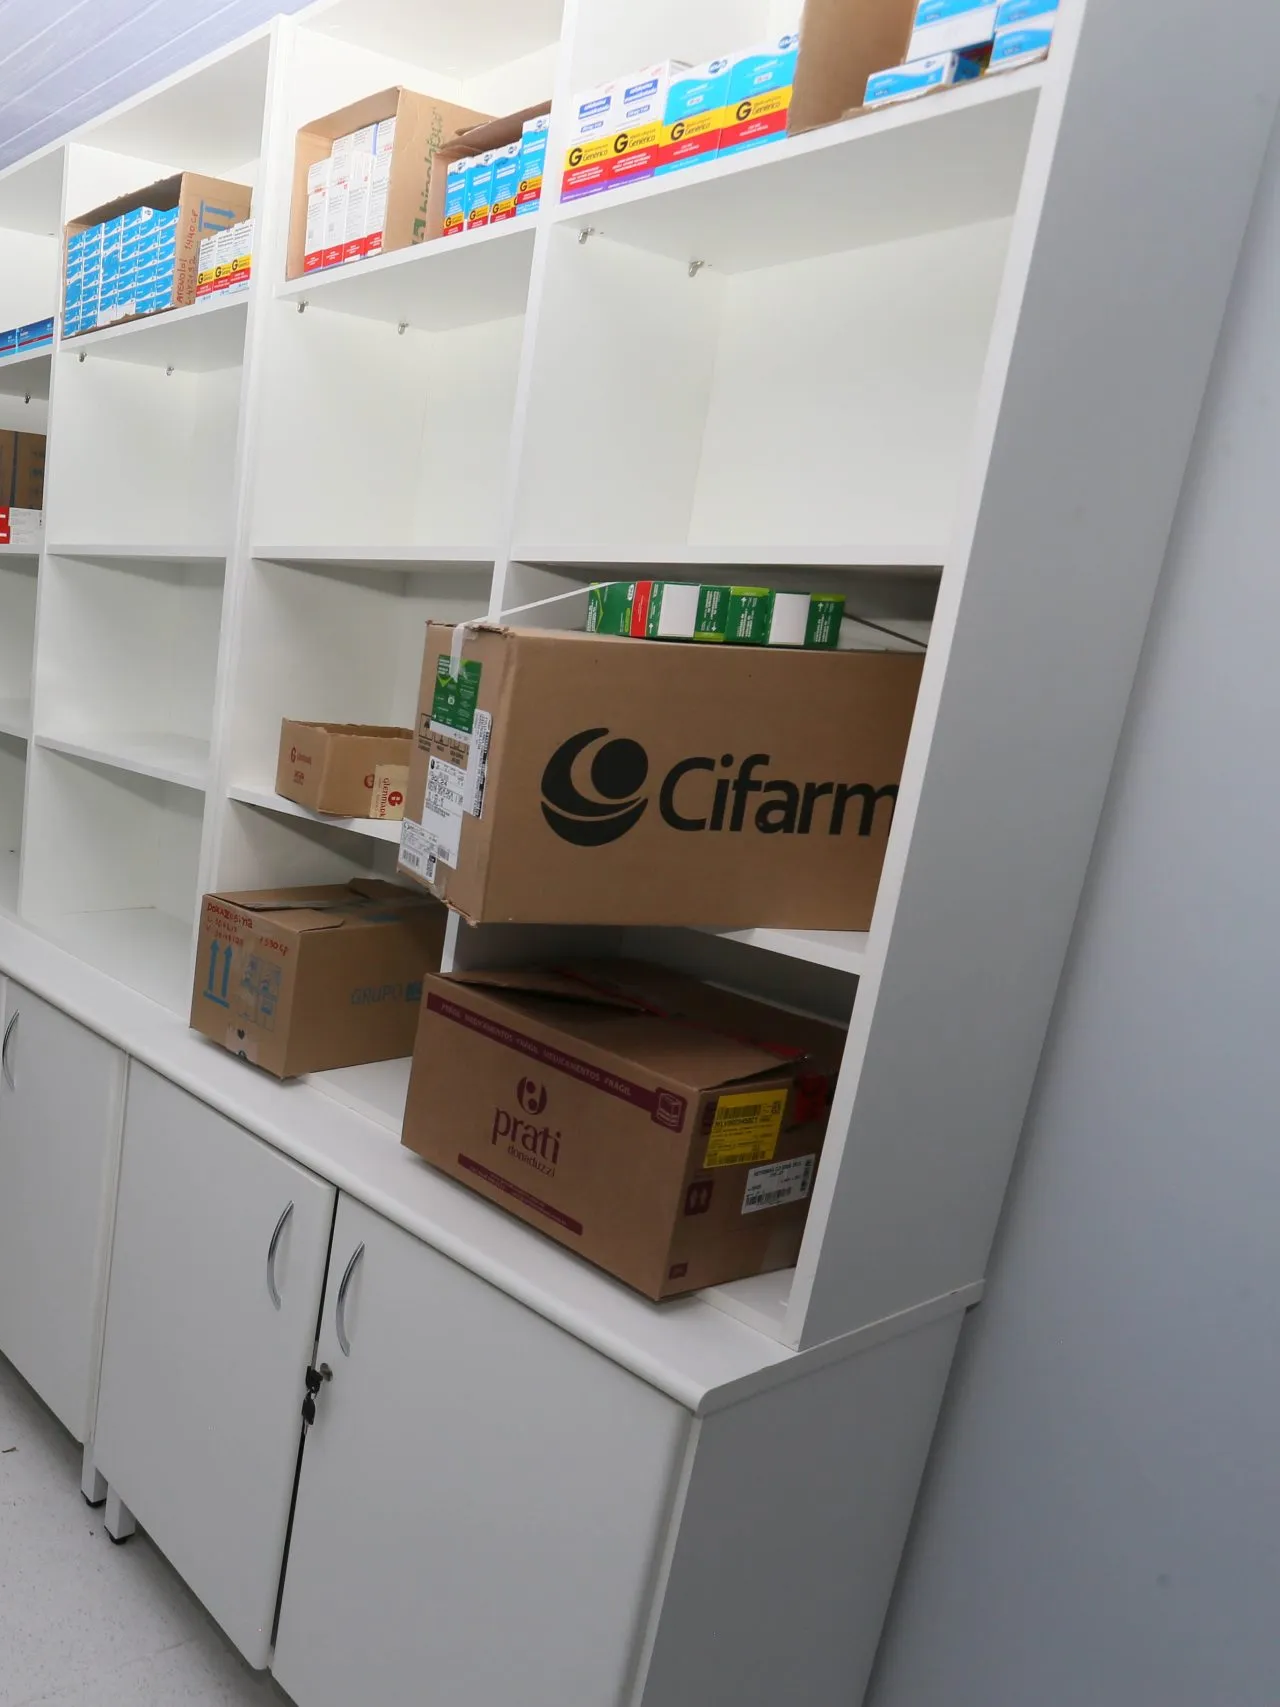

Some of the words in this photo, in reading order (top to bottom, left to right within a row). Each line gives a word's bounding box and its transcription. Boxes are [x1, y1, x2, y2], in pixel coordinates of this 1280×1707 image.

[736, 101, 752, 121] G
[670, 122, 685, 141] G
[613, 133, 629, 154] G
[568, 147, 582, 168] G
[492, 1107, 562, 1165] prati
[507, 1144, 556, 1179] donaduzzi
